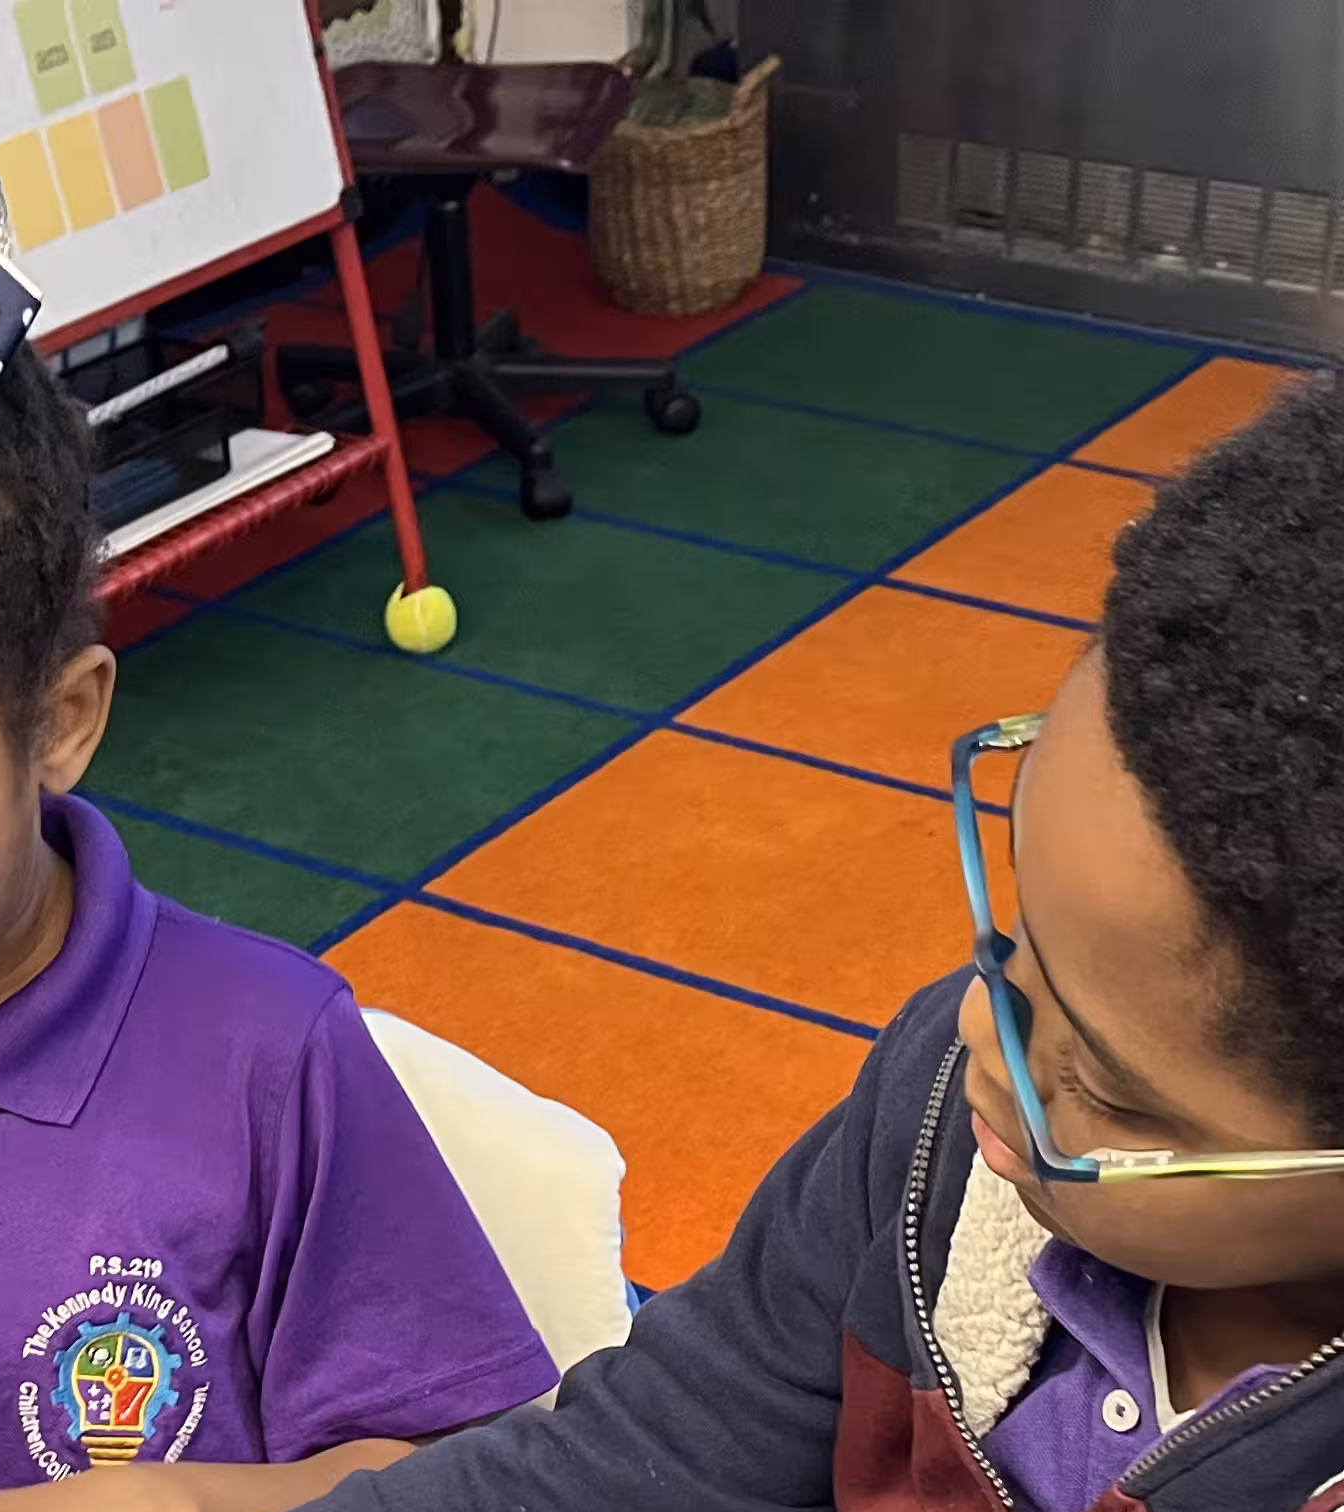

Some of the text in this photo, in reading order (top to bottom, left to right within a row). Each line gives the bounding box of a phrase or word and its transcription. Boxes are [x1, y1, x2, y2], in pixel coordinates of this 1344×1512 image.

[23, 1281, 208, 1367] The Kennedy King School
